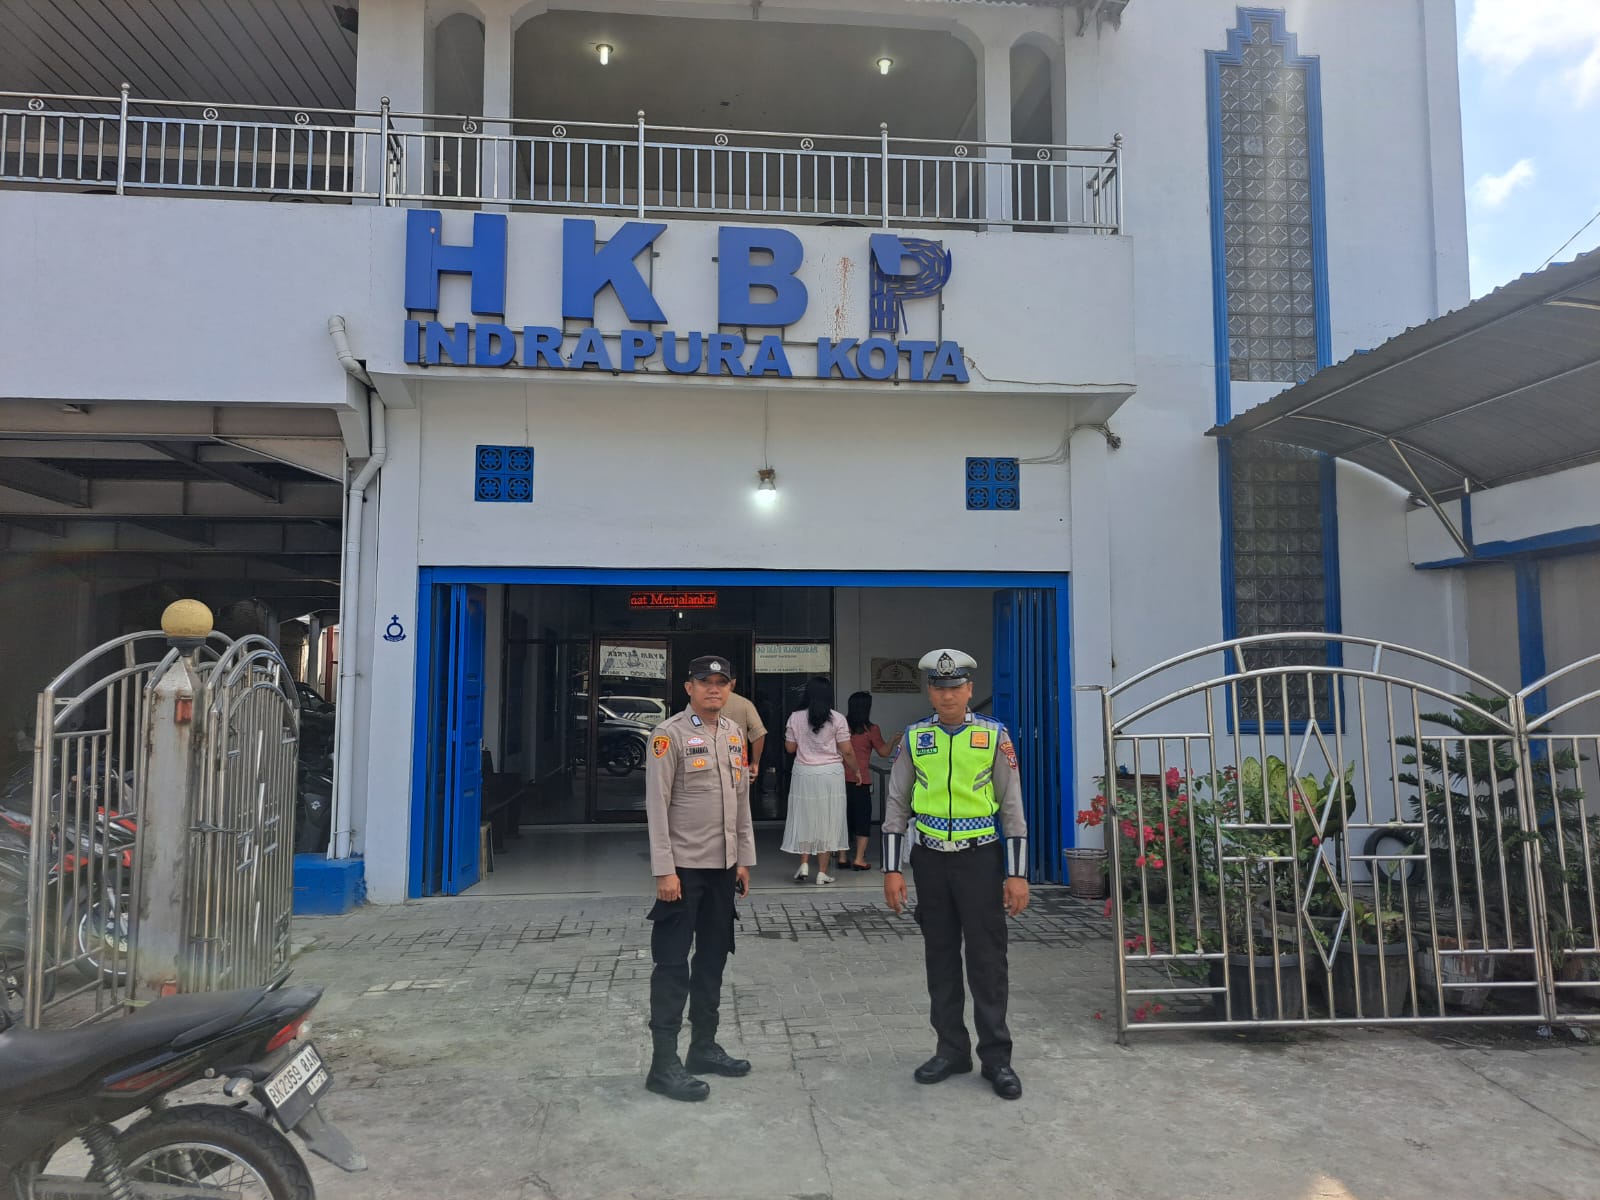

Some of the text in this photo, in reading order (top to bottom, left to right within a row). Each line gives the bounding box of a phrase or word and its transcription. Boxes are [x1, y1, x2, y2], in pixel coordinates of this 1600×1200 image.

[404, 209, 952, 335] HKBP
[403, 319, 970, 384] INDRAPURA KOTA
